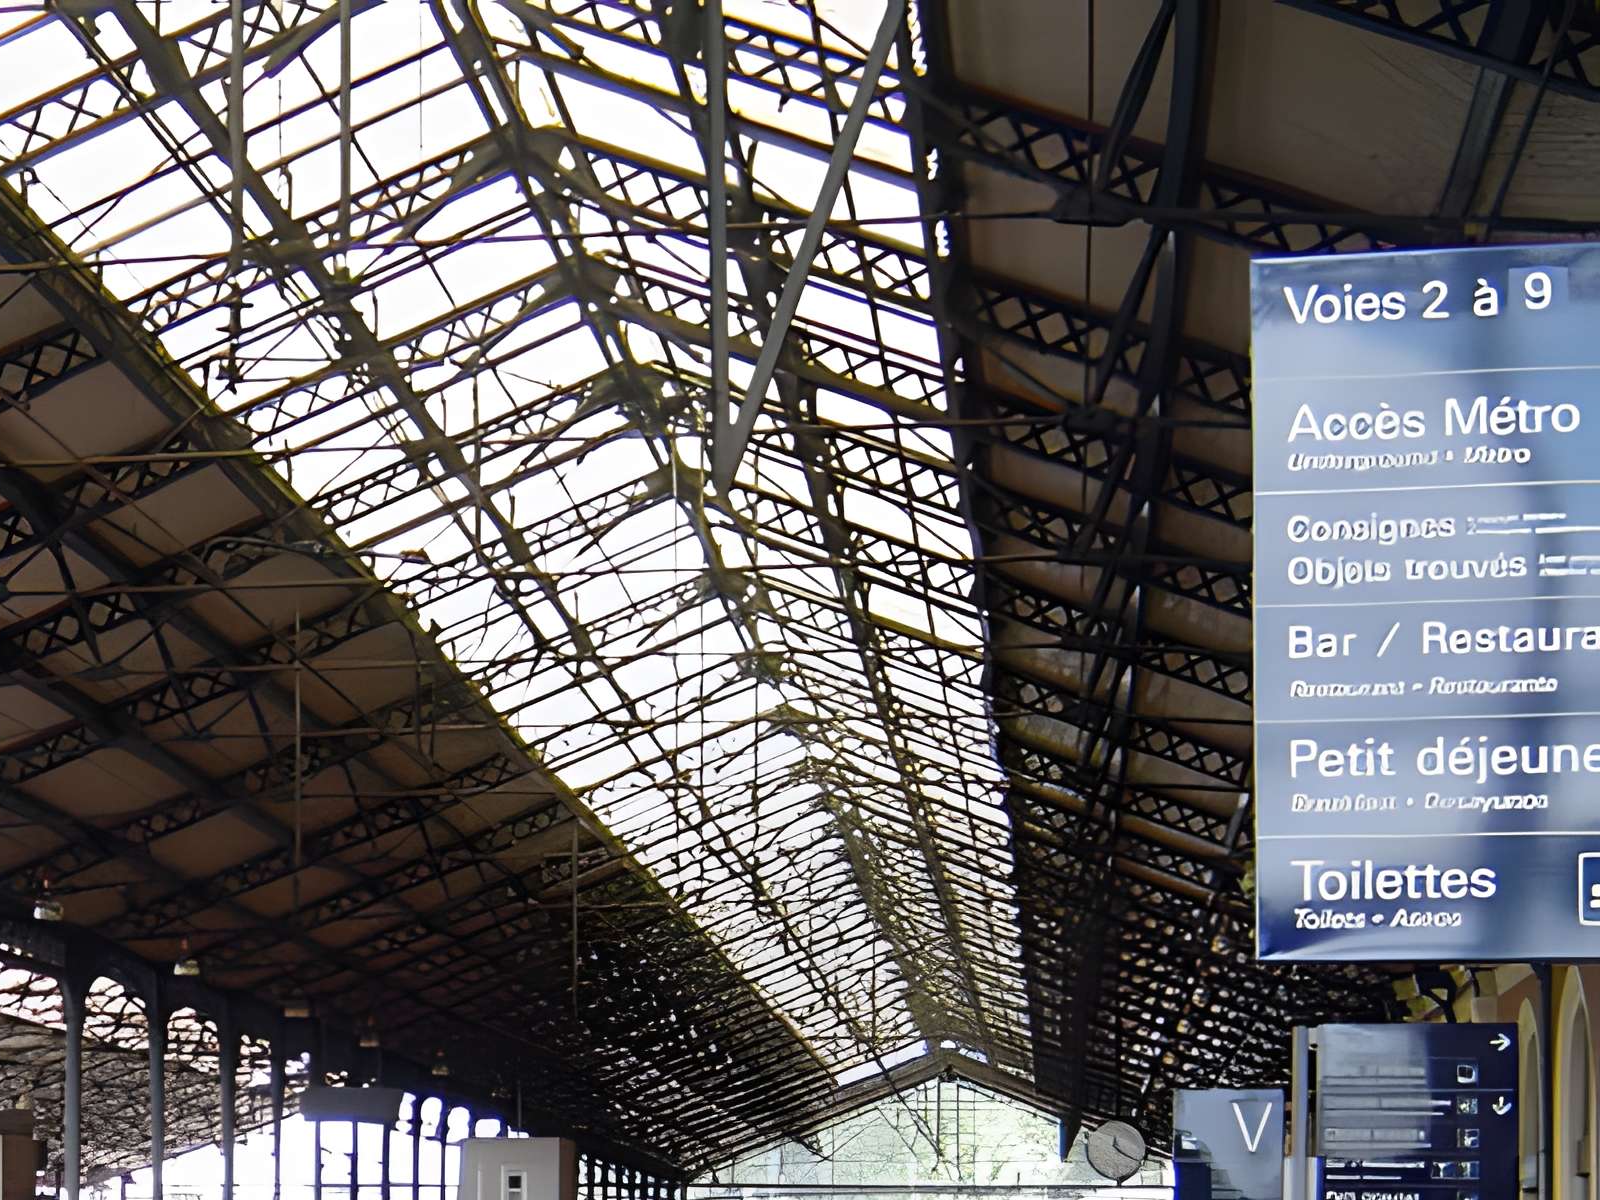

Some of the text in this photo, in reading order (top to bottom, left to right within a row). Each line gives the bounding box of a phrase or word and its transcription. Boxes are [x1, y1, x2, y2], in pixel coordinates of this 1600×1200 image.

[1283, 271, 1553, 325] Voies 2 à 9
[1287, 396, 1581, 443] Accès Métro
[1288, 624, 1357, 659] Bar
[1422, 621, 1600, 655] Restaura
[1289, 737, 1396, 778] Petit
[1289, 859, 1498, 901] Toilettes
[1232, 1101, 1273, 1153] V
